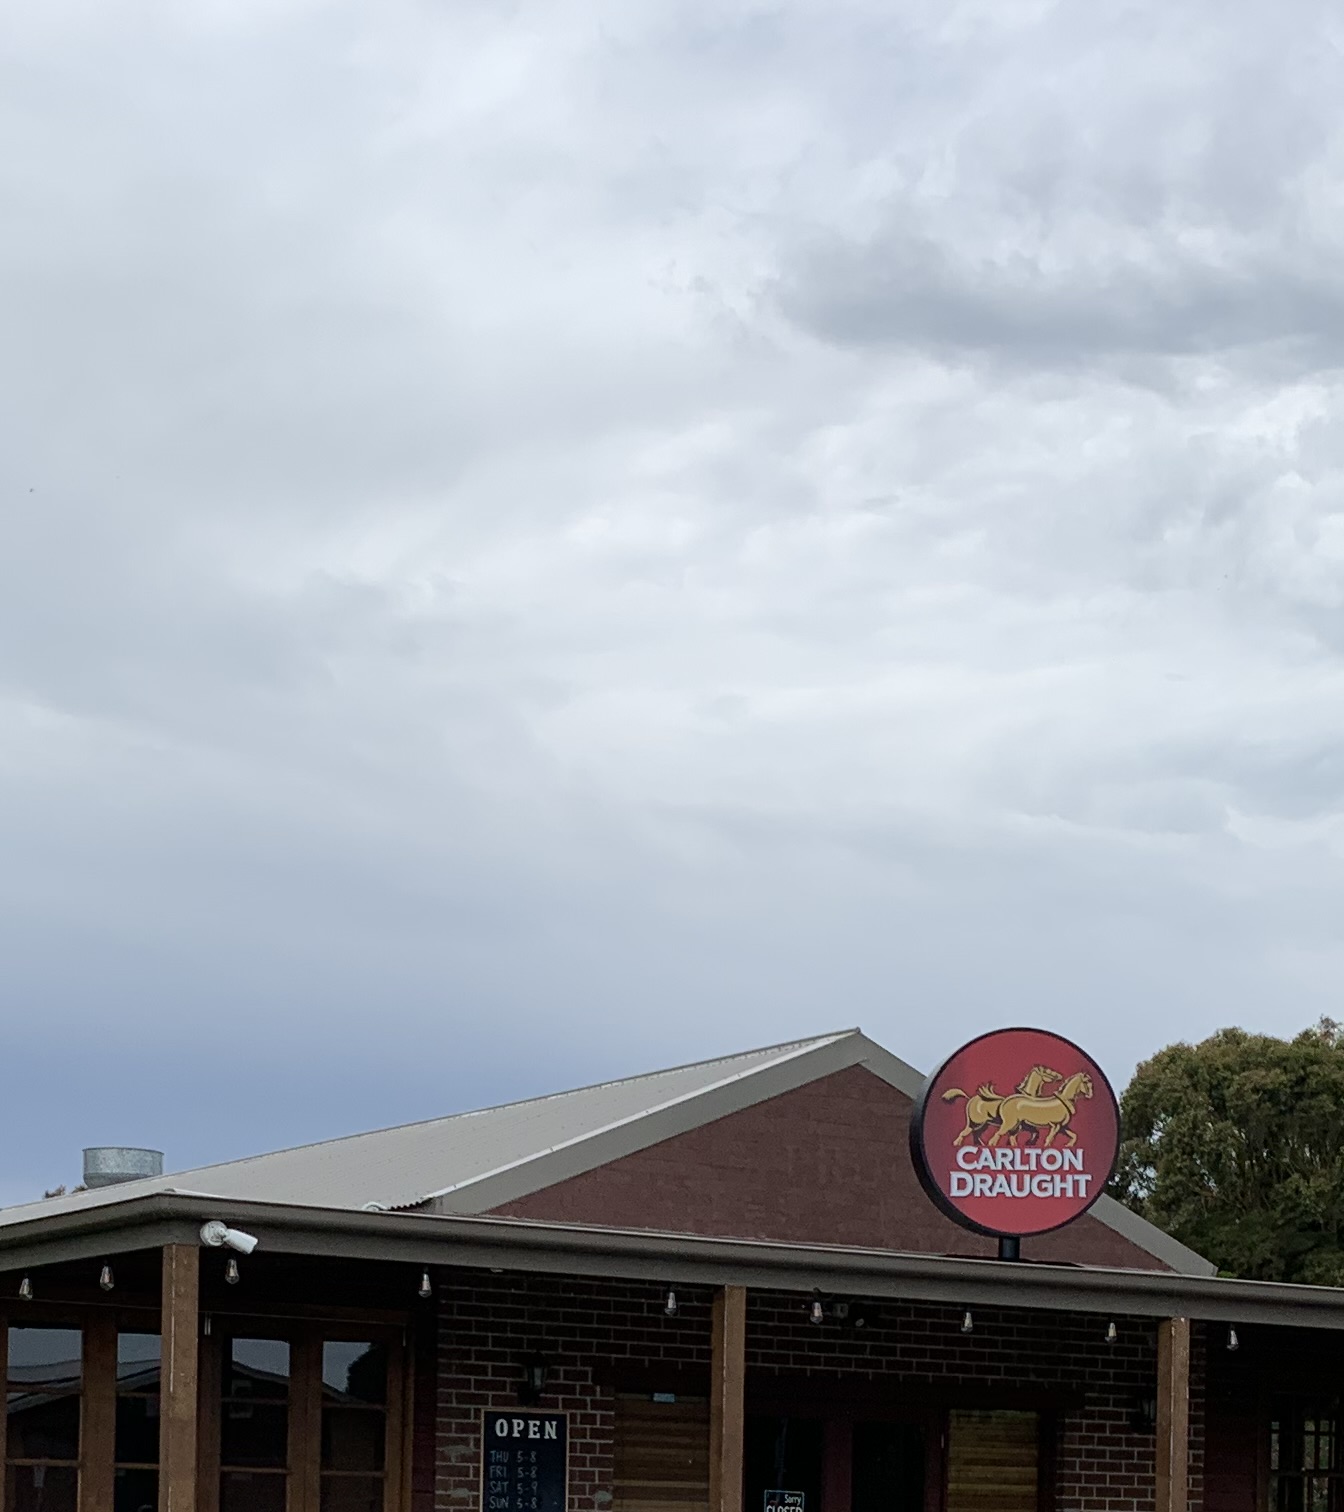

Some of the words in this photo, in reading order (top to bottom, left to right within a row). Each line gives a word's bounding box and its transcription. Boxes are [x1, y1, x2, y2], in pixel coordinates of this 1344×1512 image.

[955, 1145, 1085, 1171] CARLTON
[949, 1171, 1093, 1198] DRAUGHT
[494, 1418, 558, 1439] OPEN
[489, 1451, 509, 1463] THU
[489, 1466, 508, 1478] FRI
[489, 1481, 509, 1493] SAT
[489, 1497, 509, 1509] SUN
[784, 1494, 802, 1506] Sorry
